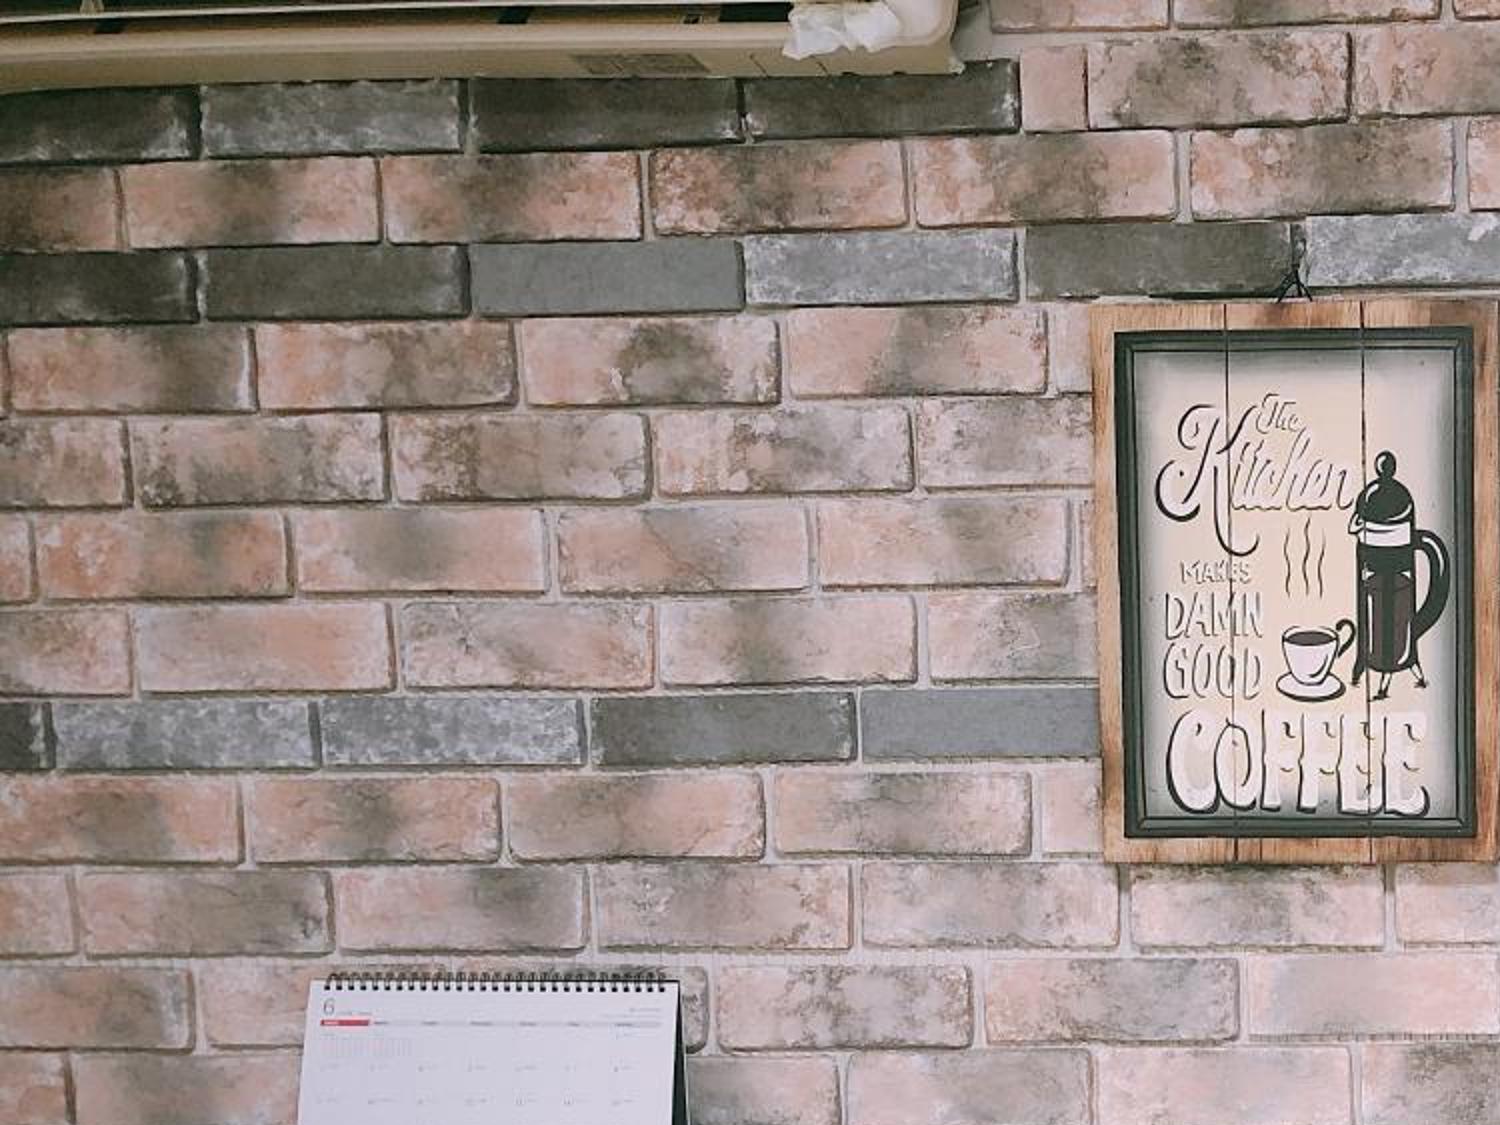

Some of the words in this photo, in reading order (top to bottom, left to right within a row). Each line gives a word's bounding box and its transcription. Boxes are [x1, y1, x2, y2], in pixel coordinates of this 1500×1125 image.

[1256, 392, 1302, 434] The
[1154, 404, 1356, 557] Kitchen
[1180, 558, 1254, 584] MAKES
[1164, 591, 1263, 640] DAMN
[1162, 641, 1262, 699] GOOD
[1165, 710, 1431, 816] COFFEE
[323, 999, 336, 1014] 6
